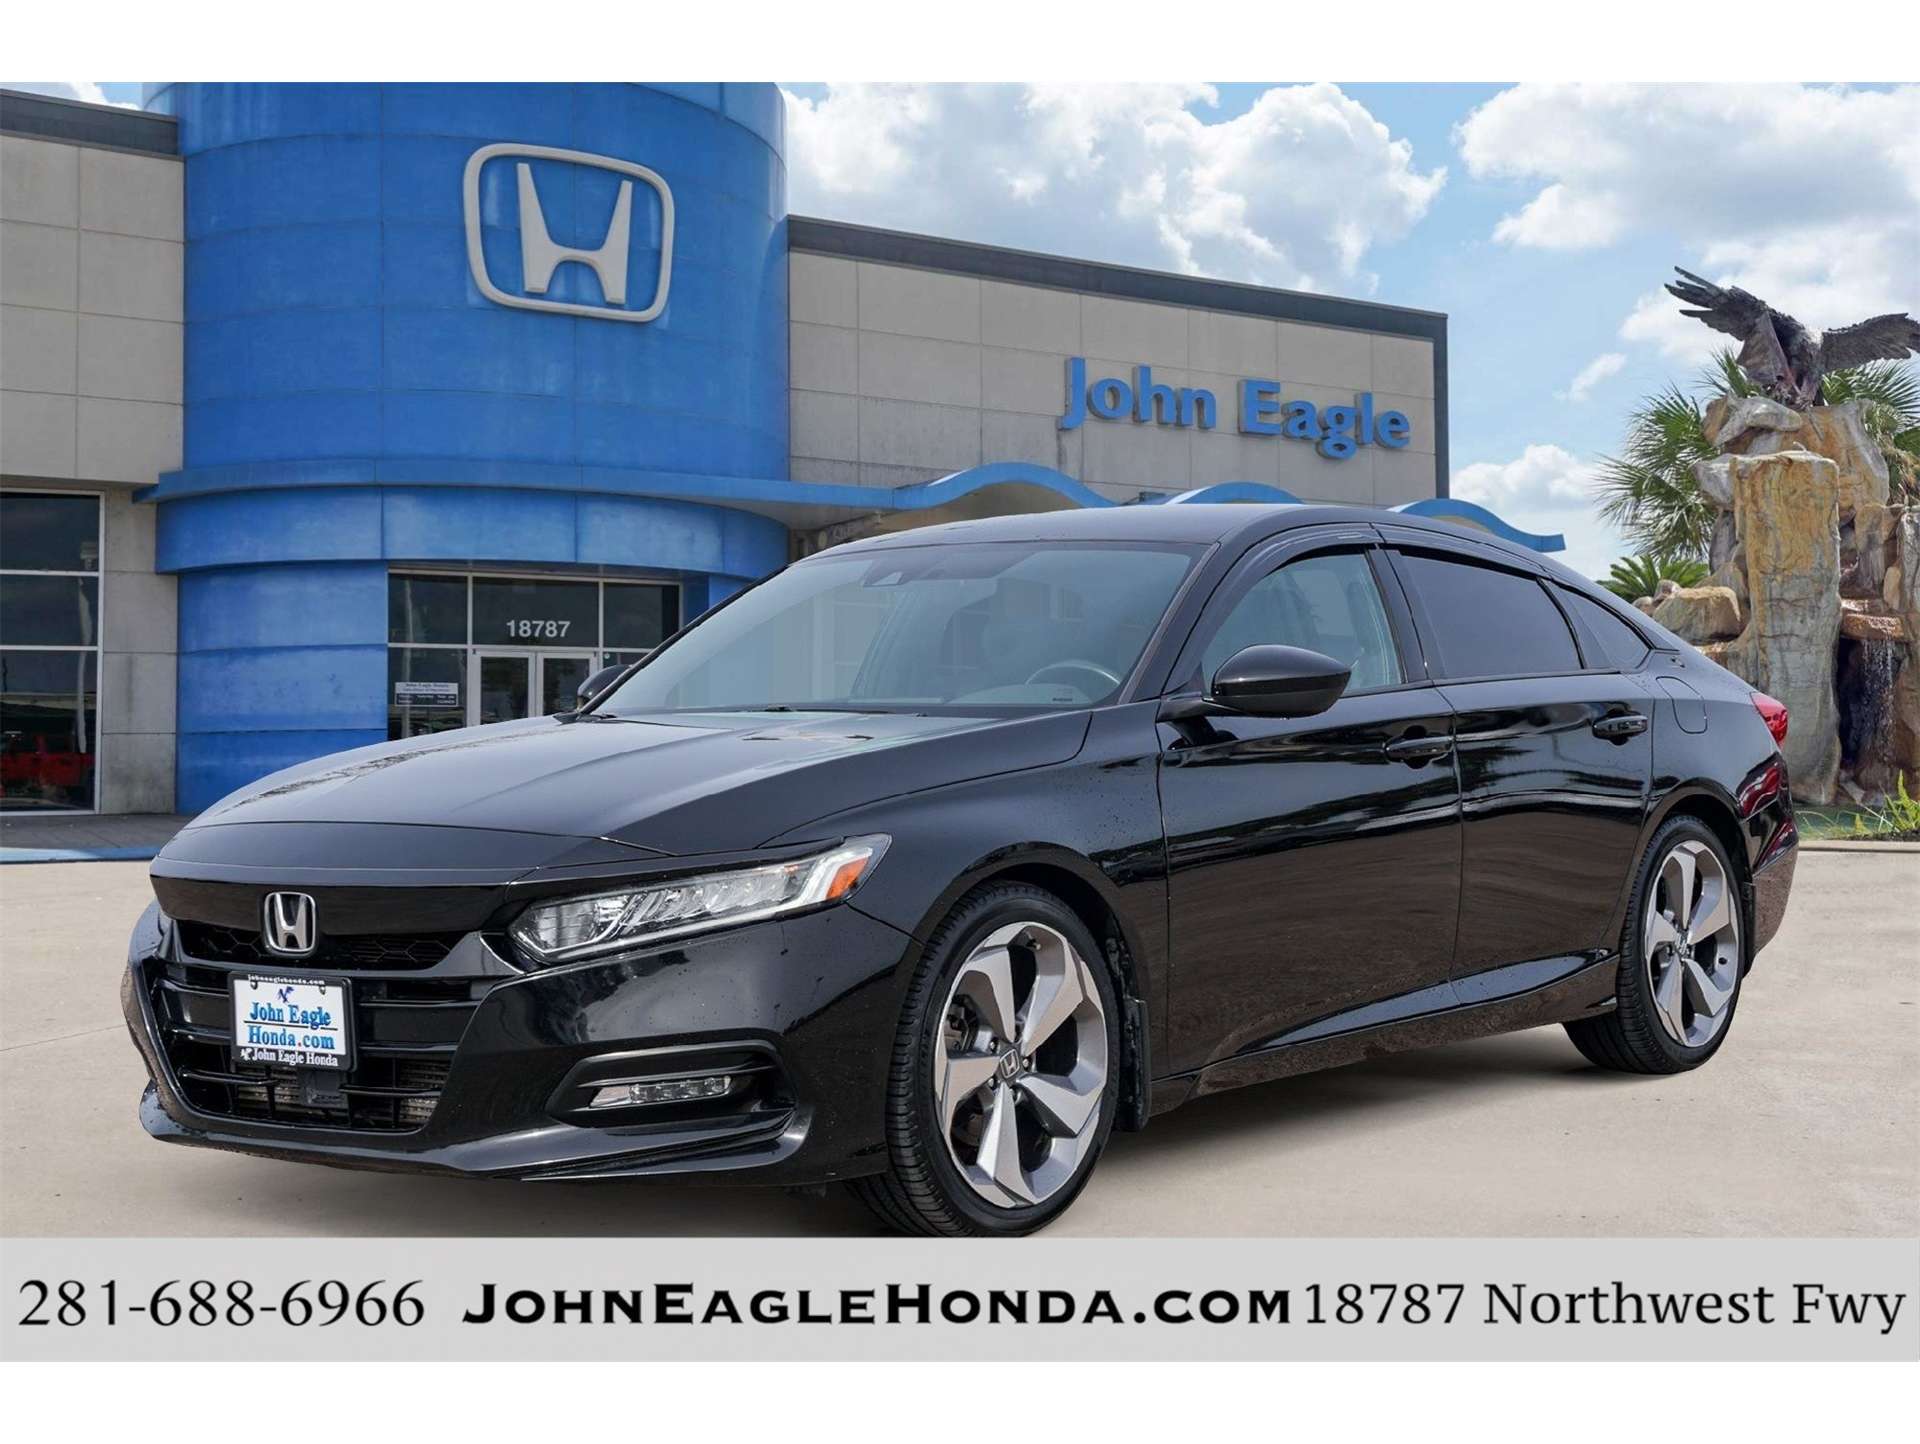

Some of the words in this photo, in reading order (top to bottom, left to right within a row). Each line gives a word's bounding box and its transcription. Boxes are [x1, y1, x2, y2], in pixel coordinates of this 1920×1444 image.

[1056, 356, 1216, 430] John
[1238, 378, 1410, 460] Eagle
[506, 620, 571, 638] 18787
[250, 1002, 284, 1021] John
[289, 1005, 331, 1030] Eagle
[248, 1025, 335, 1049] Honda.com
[252, 1048, 276, 1061] John
[278, 1050, 304, 1065] Eagle
[306, 1052, 338, 1066] Honda
